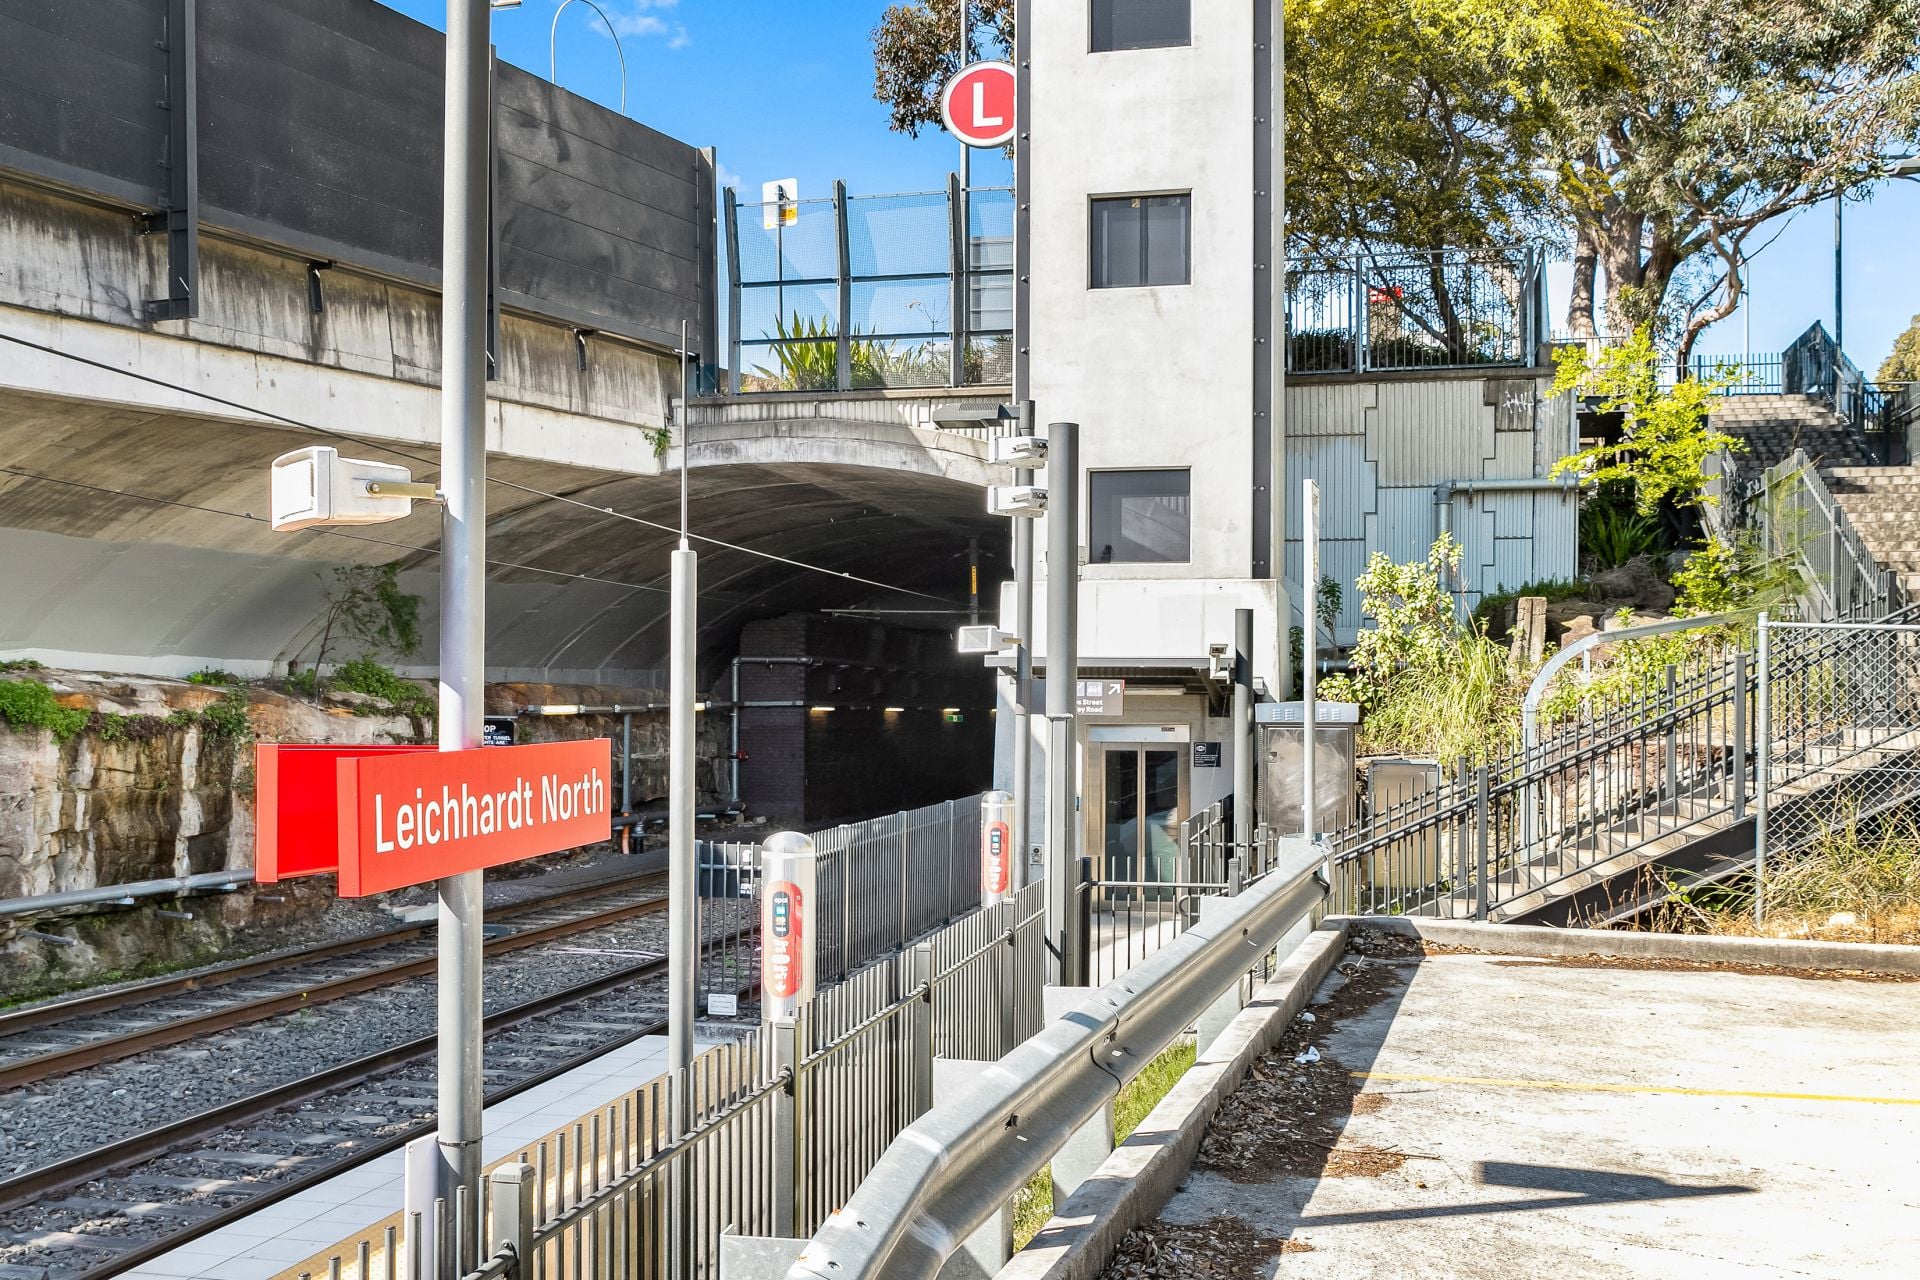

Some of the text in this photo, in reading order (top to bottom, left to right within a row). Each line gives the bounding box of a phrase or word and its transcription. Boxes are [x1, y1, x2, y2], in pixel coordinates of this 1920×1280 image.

[973, 81, 1003, 128] L
[1082, 698, 1103, 706] Street
[484, 724, 496, 733] OP
[375, 767, 604, 854] Leichhardt North
